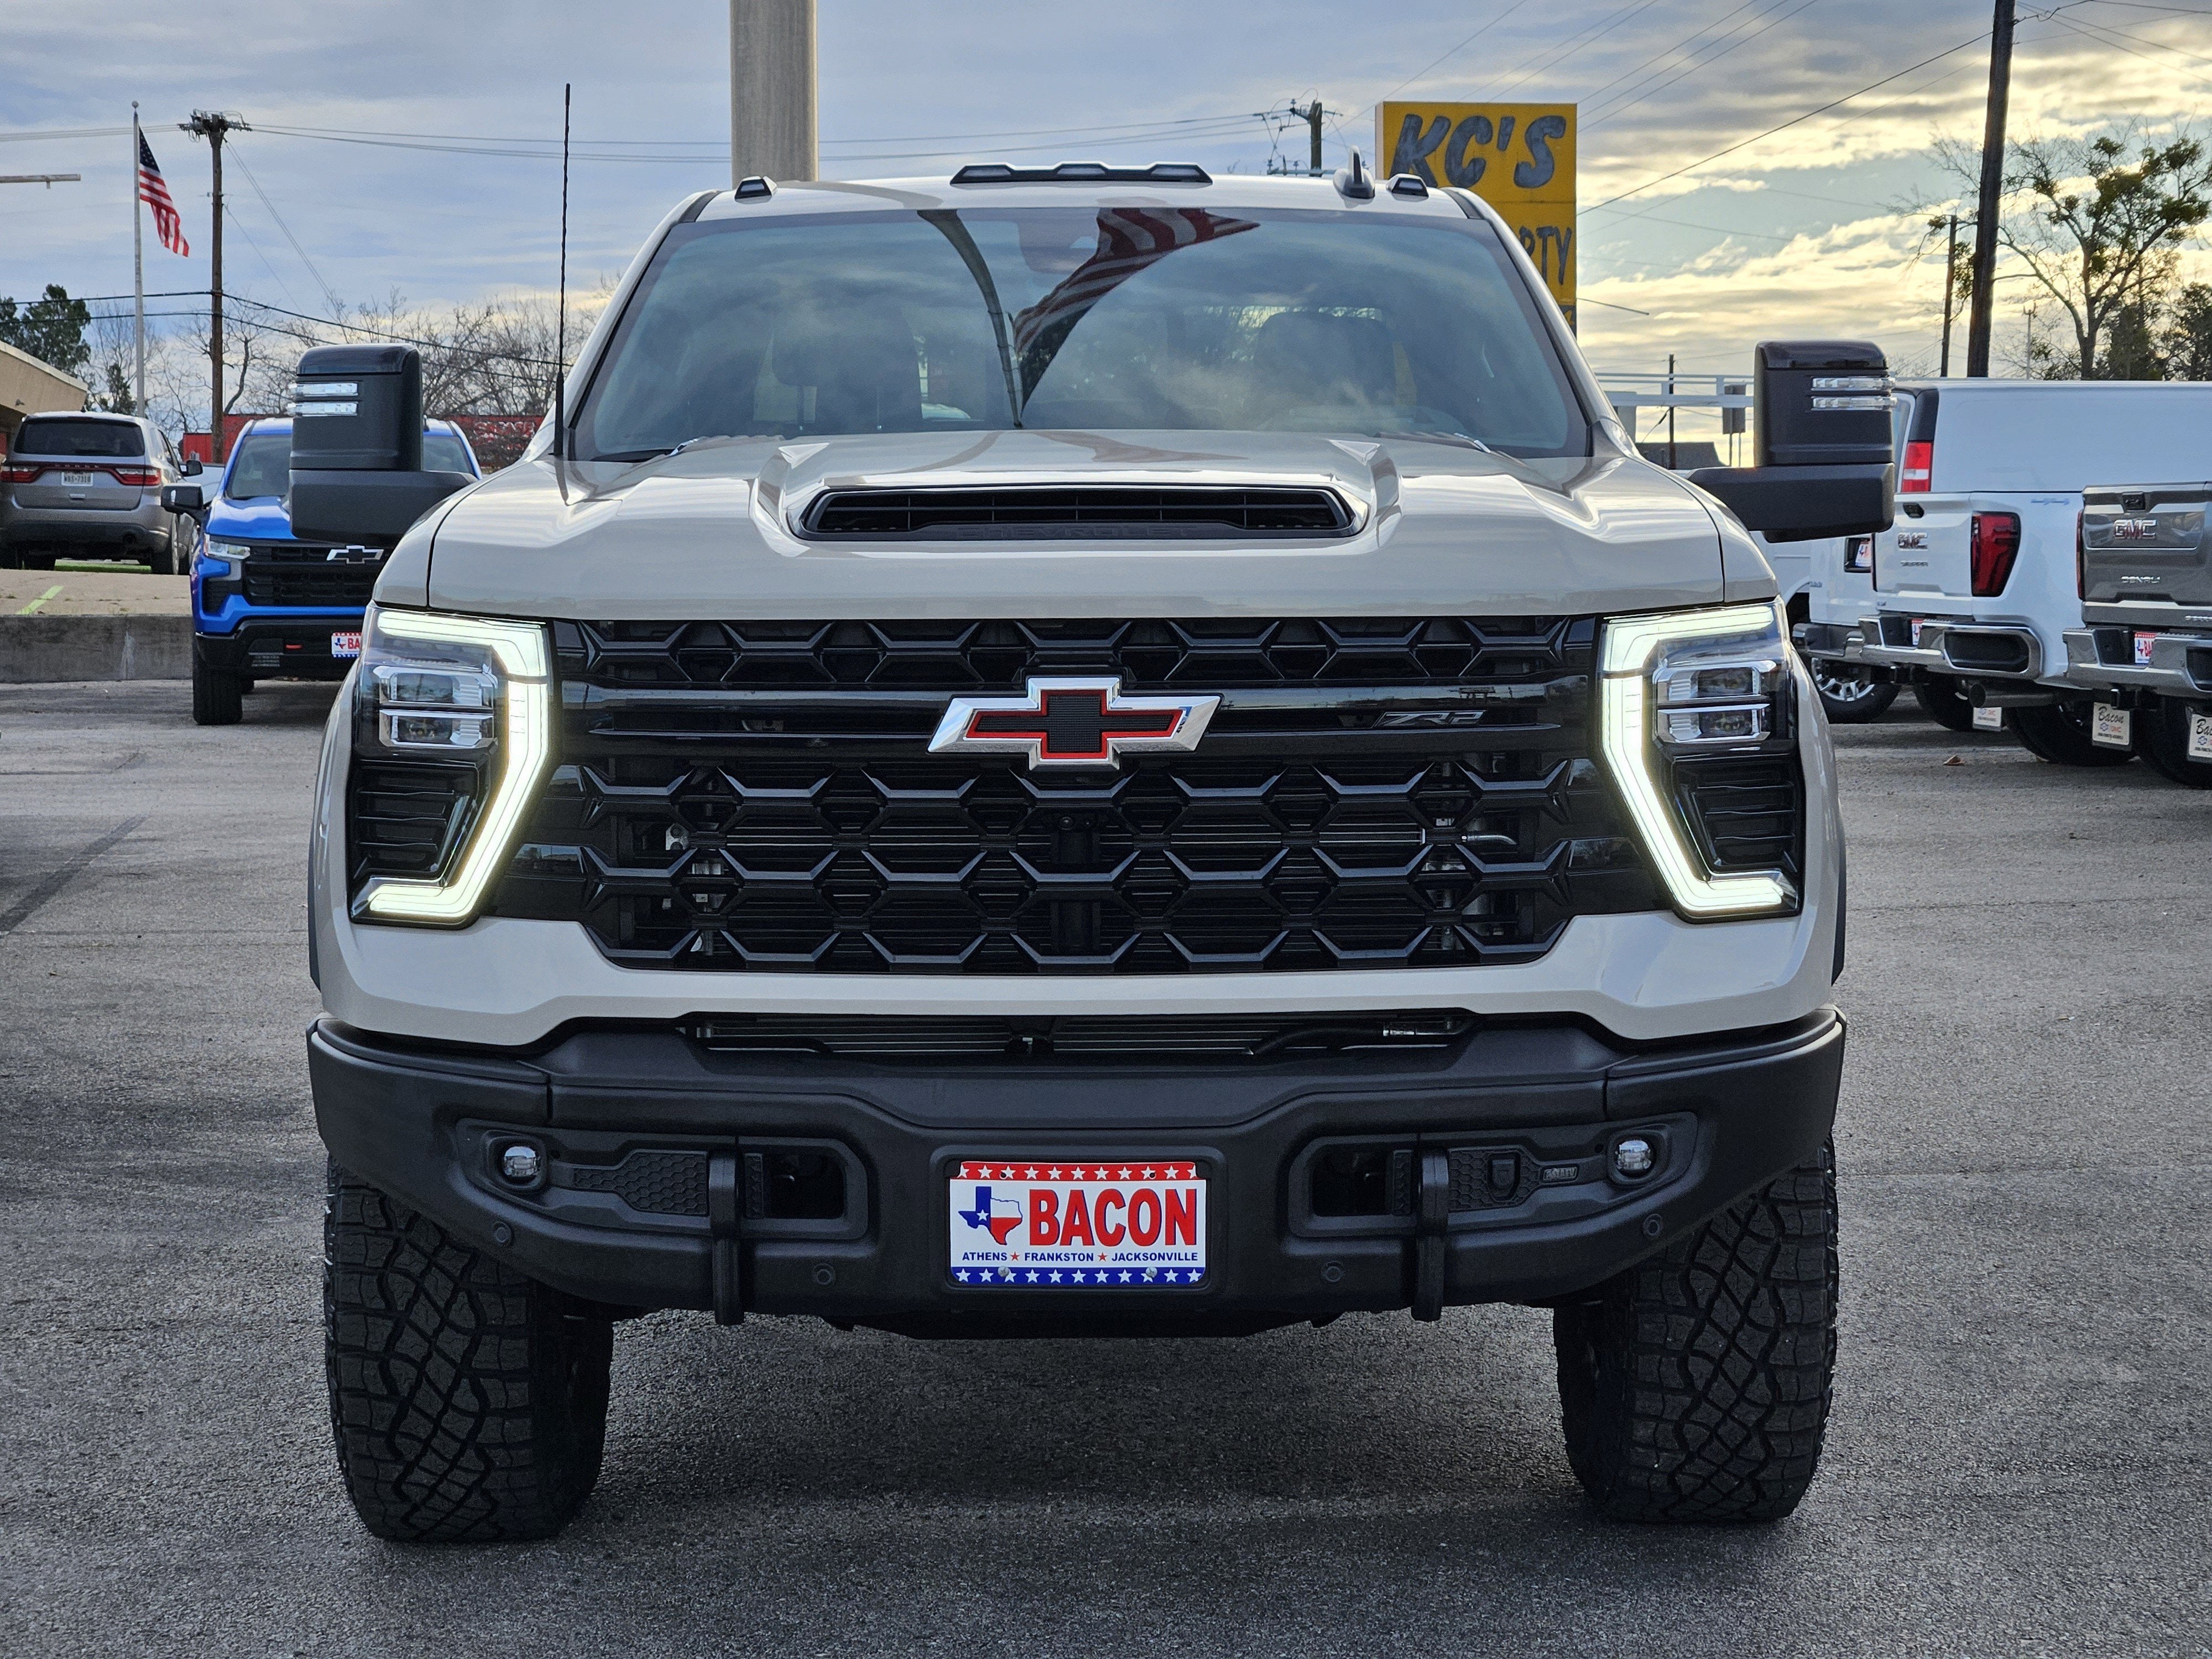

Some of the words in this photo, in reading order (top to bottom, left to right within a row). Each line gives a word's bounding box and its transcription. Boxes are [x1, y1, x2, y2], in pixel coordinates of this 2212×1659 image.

[1389, 113, 1566, 189] KC'S
[956, 525, 1198, 538] CHEVROLET
[2114, 519, 2156, 540] GMC
[1380, 711, 1485, 727] ZR2
[1029, 1188, 1197, 1247] BACON
[962, 1252, 1008, 1261] ATHENS
[1024, 1251, 1094, 1261] FRANKSTON
[1111, 1251, 1198, 1261] JACKSONVILLE
